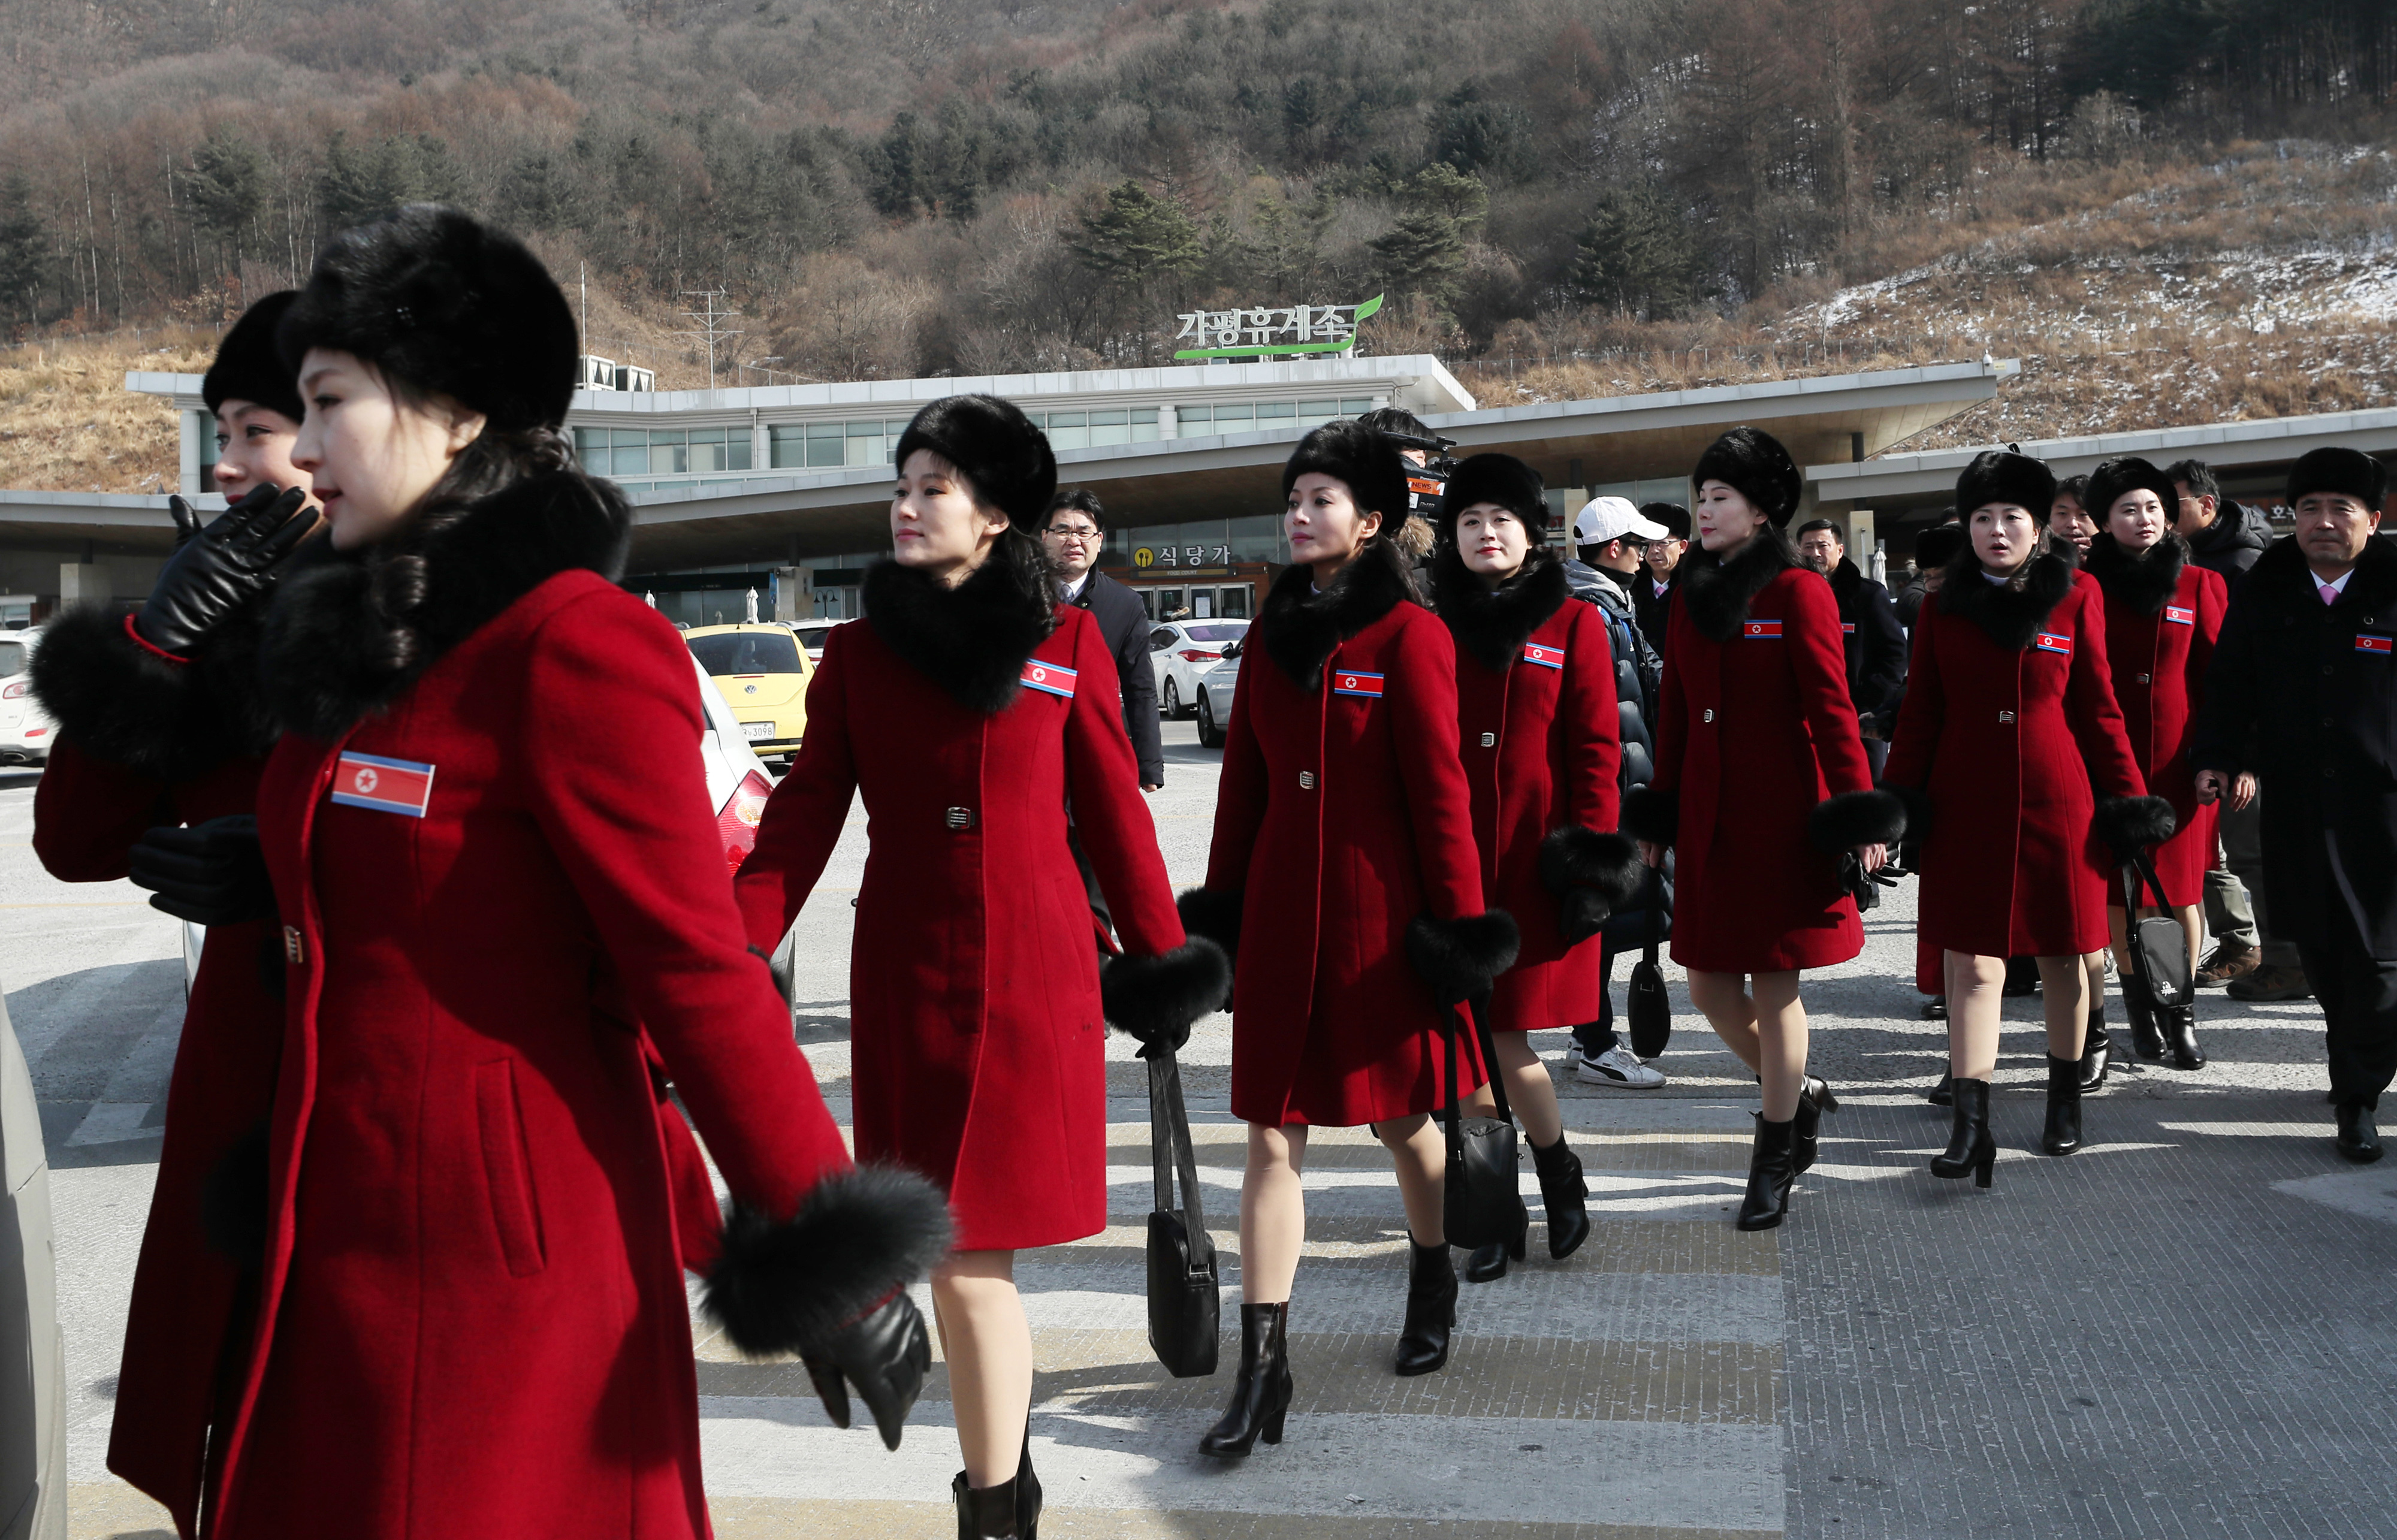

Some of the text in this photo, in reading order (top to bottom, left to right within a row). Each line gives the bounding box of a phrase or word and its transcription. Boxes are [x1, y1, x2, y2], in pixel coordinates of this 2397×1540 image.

[1176, 304, 1348, 346] 가평휴게소
[1436, 482, 1445, 496] 1
[1159, 545, 1231, 567] 식당가
